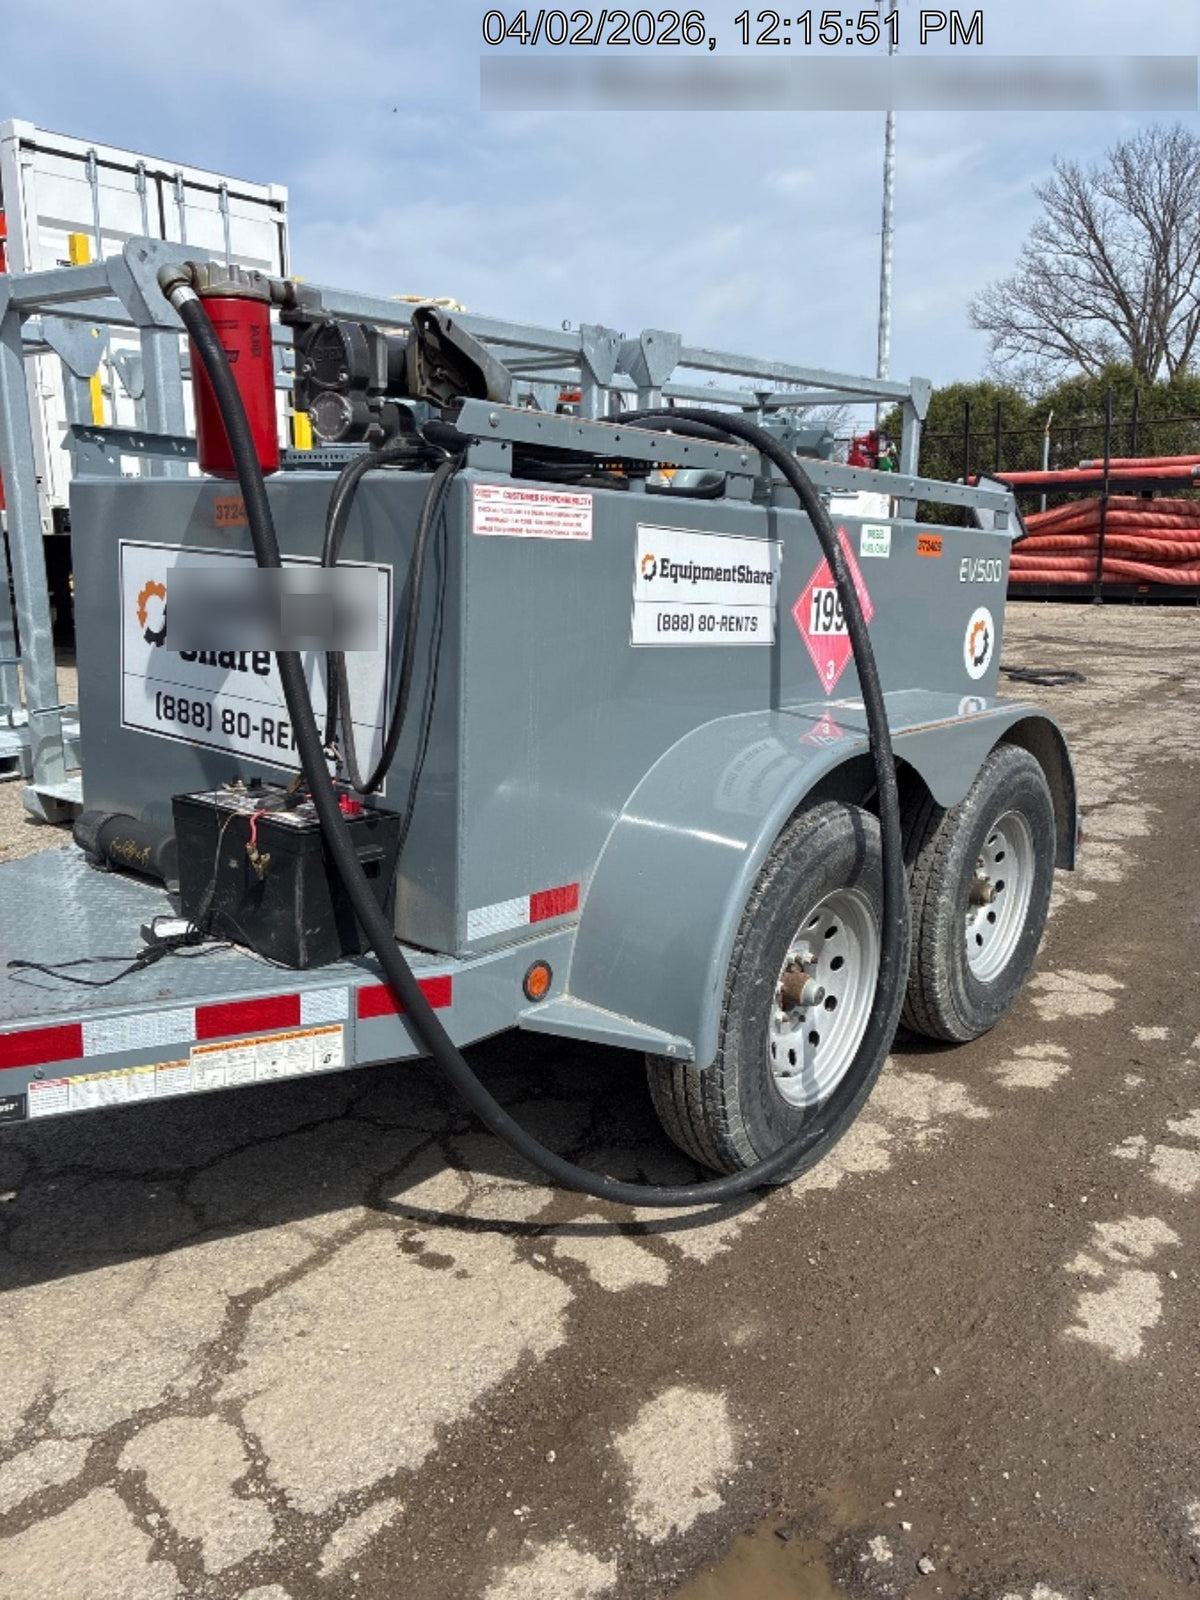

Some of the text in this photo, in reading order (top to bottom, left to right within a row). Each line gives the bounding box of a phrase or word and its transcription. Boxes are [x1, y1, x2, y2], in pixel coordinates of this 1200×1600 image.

[659, 558, 774, 585] EquipmentShare
[960, 557, 1002, 582] EV500
[657, 613, 758, 633] (888) 80-RENTS
[814, 590, 845, 632] 199
[826, 659, 835, 680] 3
[156, 691, 212, 733] (888)
